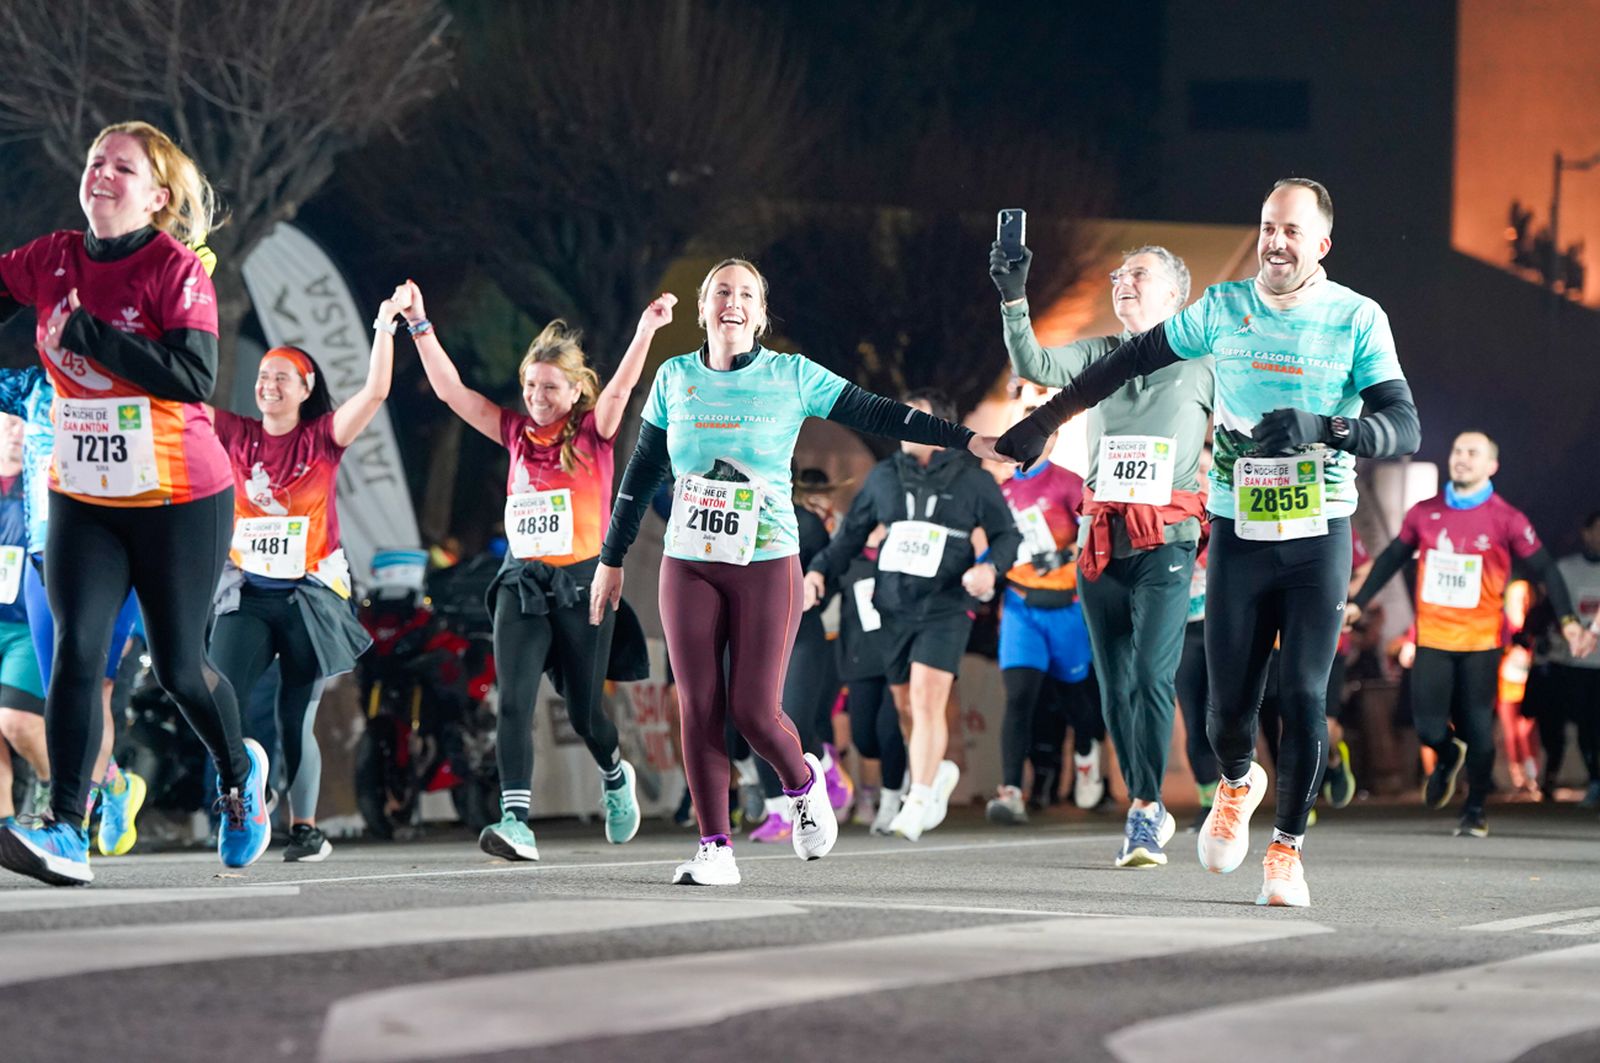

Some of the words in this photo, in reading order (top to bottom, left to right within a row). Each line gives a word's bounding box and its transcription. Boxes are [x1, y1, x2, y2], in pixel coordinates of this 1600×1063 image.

[61, 350, 87, 377] 43
[1251, 361, 1304, 375] QUESADA
[1254, 351, 1305, 366] CAZORLA
[1306, 357, 1346, 371] TRAILS
[95, 410, 108, 421] DE
[697, 414, 741, 422] CAZORLA
[743, 415, 777, 424] TRAILS
[63, 421, 78, 431] SAN
[694, 421, 741, 429] QUESADA
[72, 434, 129, 463] 7213
[1113, 460, 1157, 480] 4821
[1253, 467, 1278, 476] NOCHE
[1279, 466, 1289, 476] DE
[1244, 477, 1260, 486] SAN
[716, 490, 727, 498] DE
[1250, 486, 1309, 512] 2855
[516, 514, 559, 535] 4838
[686, 505, 740, 535] 2166
[251, 537, 289, 555] 1481
